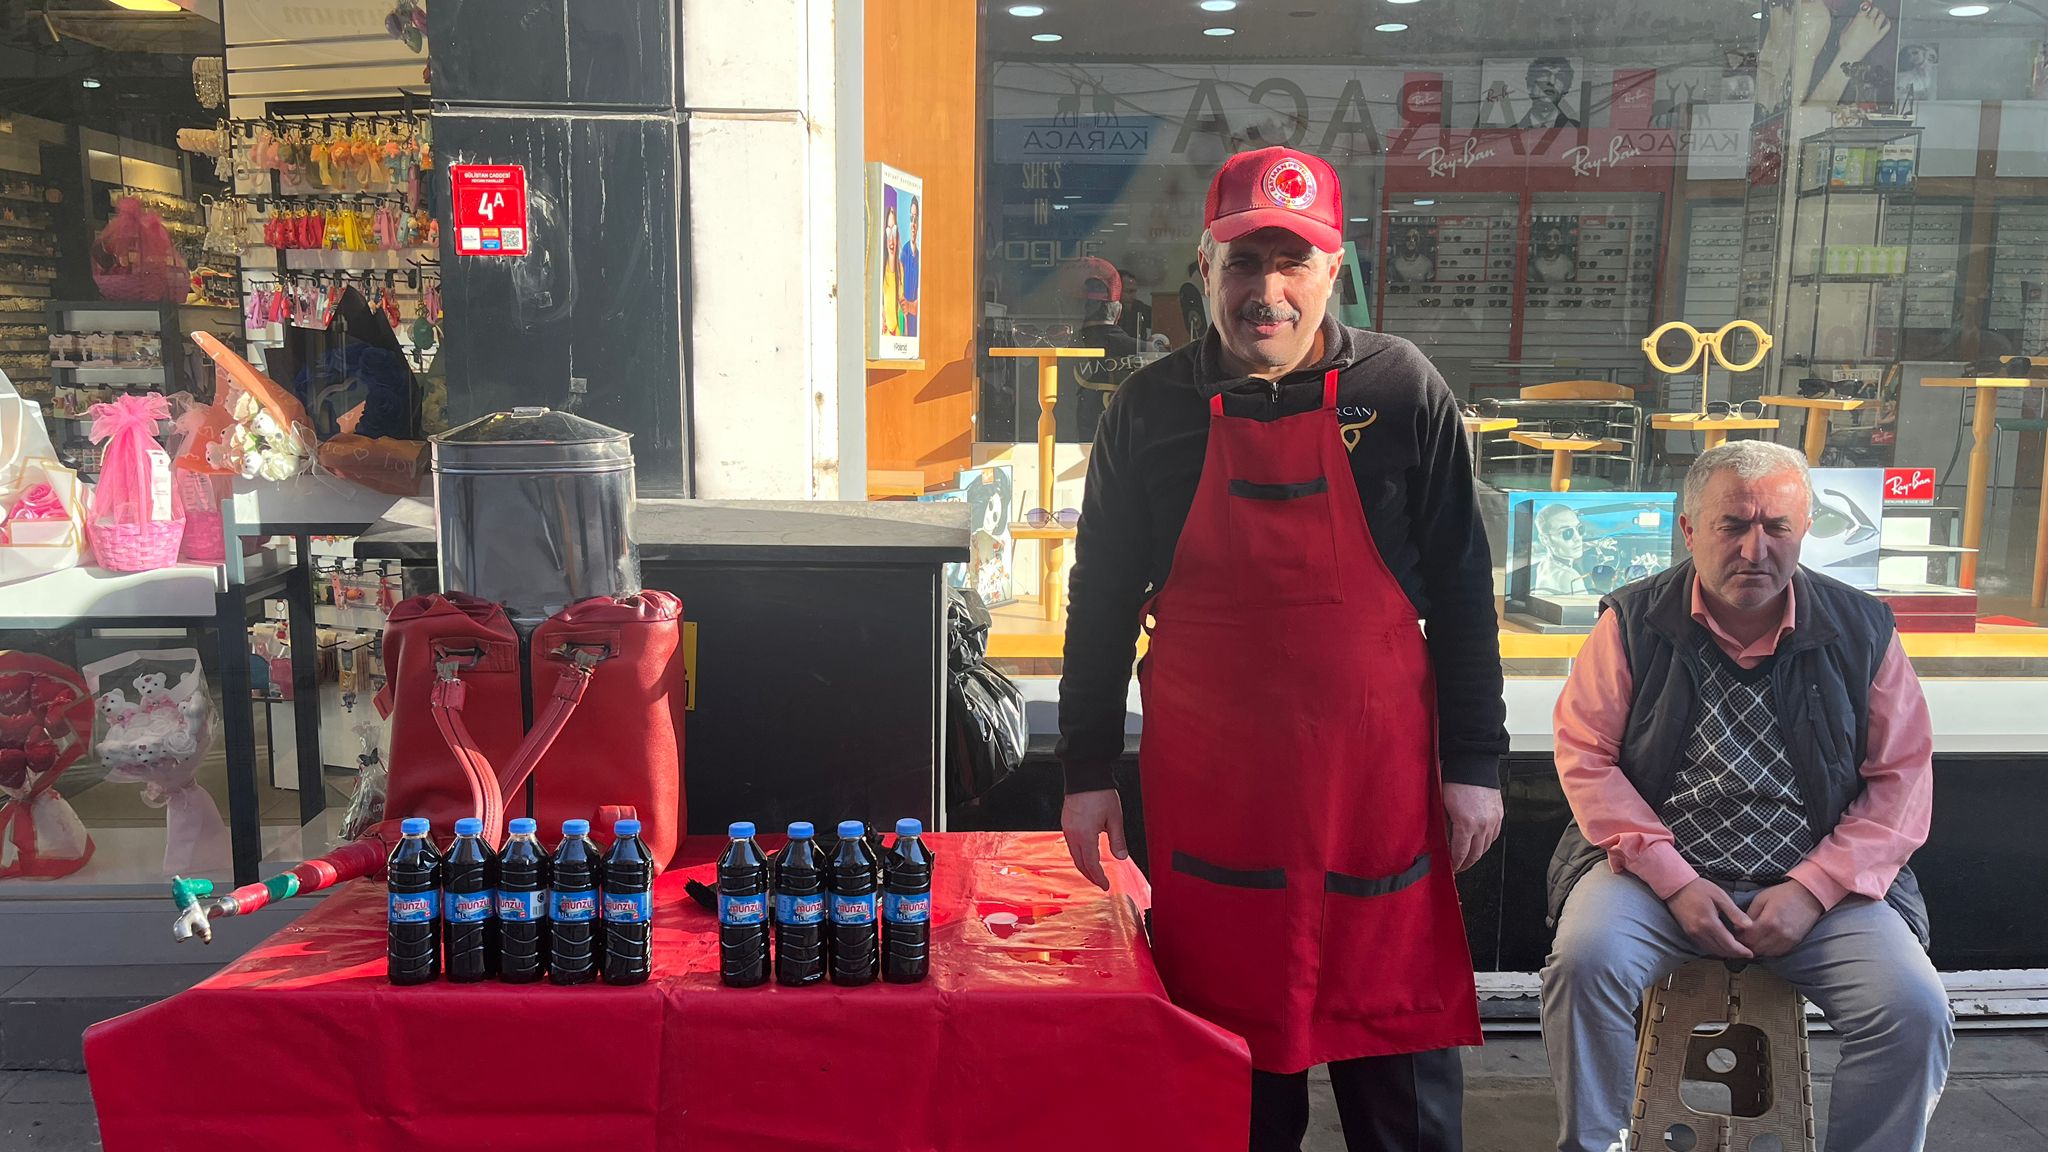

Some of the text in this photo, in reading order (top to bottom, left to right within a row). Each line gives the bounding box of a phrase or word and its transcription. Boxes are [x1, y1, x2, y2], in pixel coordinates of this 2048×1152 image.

[1417, 137, 1496, 178] Ray-Ban
[1561, 135, 1641, 176] Ray-Ban
[1022, 161, 1063, 189] SHE'S
[1034, 199, 1048, 224] IN
[1885, 471, 1930, 495] Ray-Ban
[499, 900, 525, 909] unzur
